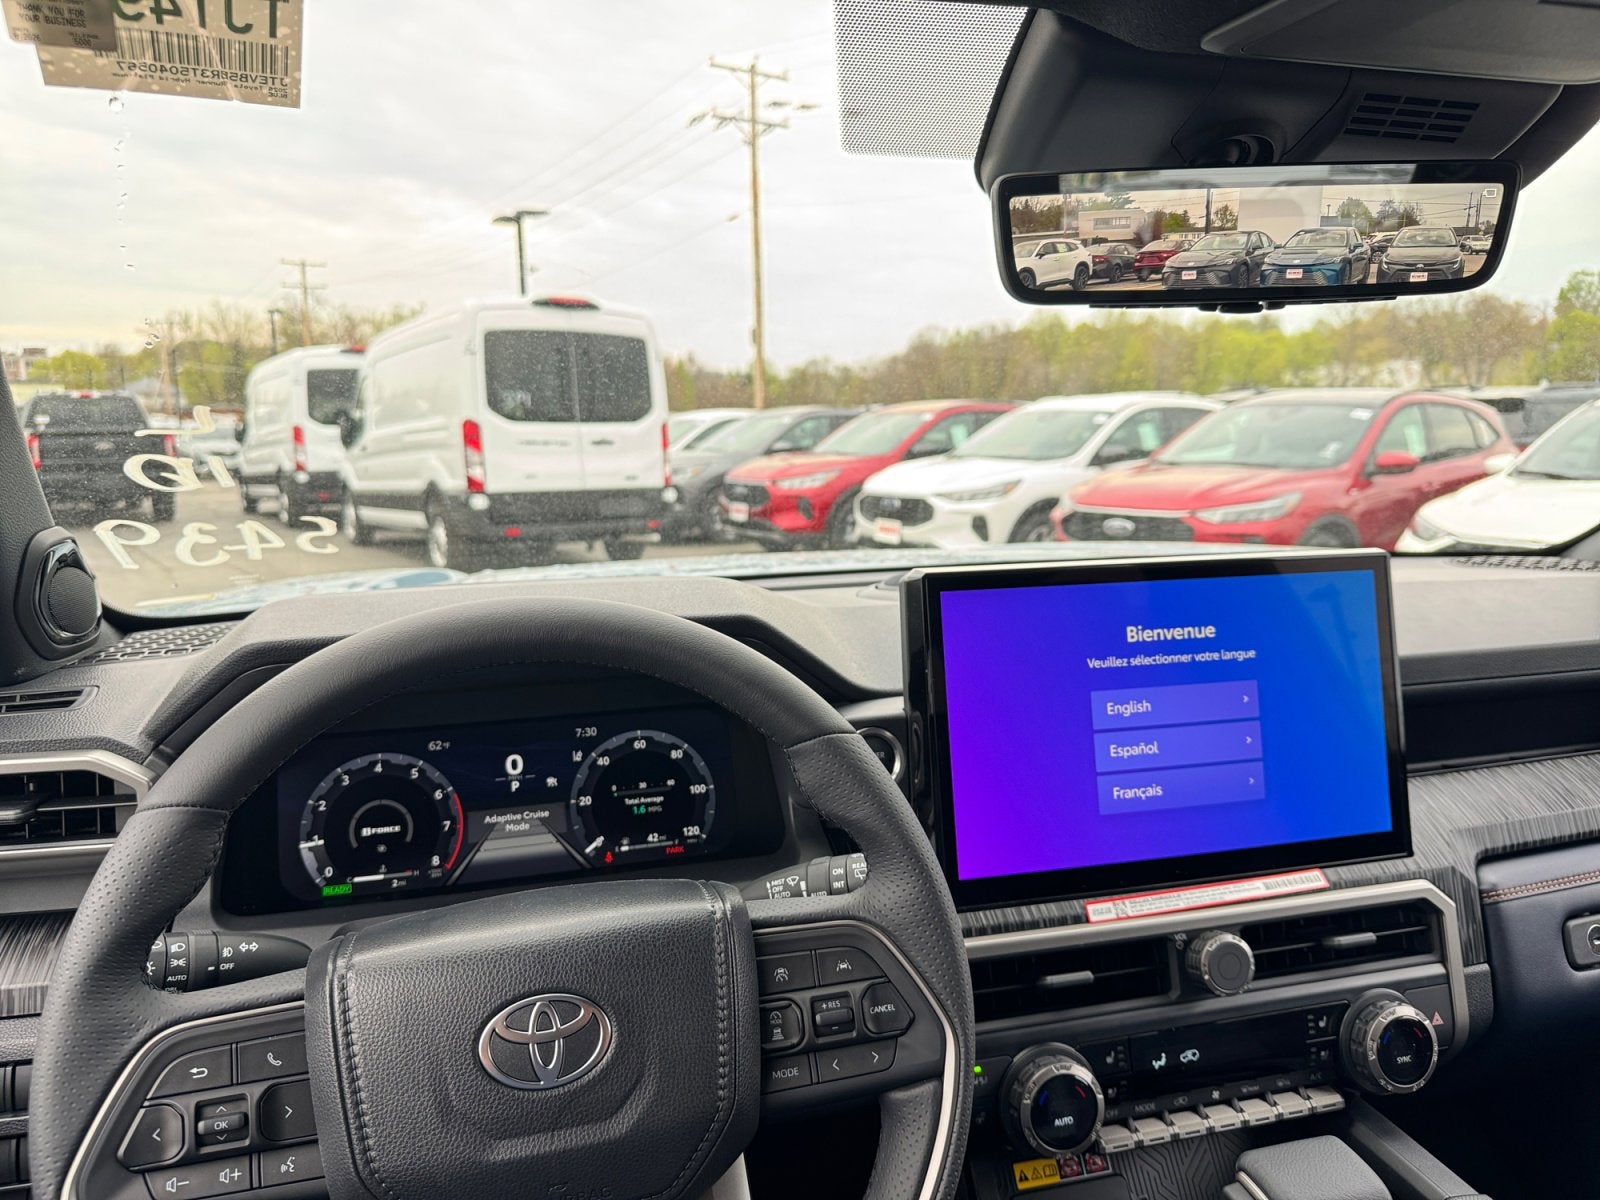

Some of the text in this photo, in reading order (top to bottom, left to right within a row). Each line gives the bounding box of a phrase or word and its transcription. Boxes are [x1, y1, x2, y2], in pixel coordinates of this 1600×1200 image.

[68, 8, 86, 18] FOR
[45, 16, 87, 28] BUSINESS
[1126, 624, 1217, 643] Bienvenue
[1087, 648, 1256, 669] Veuillez sélectionner votre langue
[1106, 700, 1152, 717] English
[575, 726, 598, 738] 7:30
[634, 740, 646, 750] 60
[1109, 741, 1159, 759] Español
[670, 749, 683, 760] 80
[505, 753, 524, 775] 0
[596, 756, 610, 767] 40
[373, 762, 383, 773] 4
[410, 767, 419, 779] 5
[342, 775, 350, 786] 3
[511, 781, 520, 792] P
[689, 784, 707, 794] 100
[1113, 784, 1163, 800] Français
[434, 789, 443, 799] 6
[318, 801, 327, 811] 2
[579, 796, 592, 806] 20
[624, 795, 665, 806] Total Average
[633, 805, 647, 814] 1.6
[484, 809, 550, 825] Adaptive Cruise
[442, 820, 451, 831] 7
[505, 822, 530, 832] Mode
[683, 826, 700, 837] 120
[666, 846, 685, 855] PARK
[432, 855, 440, 866] 8
[325, 866, 334, 877] 0
[832, 868, 844, 876] ON
[771, 878, 785, 887] MIST
[833, 880, 845, 889] INT
[325, 885, 352, 896] READY
[772, 885, 784, 893] OFF
[774, 891, 791, 900] AUTO
[219, 962, 235, 971] OFF
[166, 974, 187, 982] AUTO
[869, 1003, 896, 1014] CANCEL
[1397, 1055, 1412, 1065] SYNC
[772, 1067, 800, 1080] MODE
[213, 1119, 229, 1131] OK
[1054, 1115, 1075, 1127] AUTO
